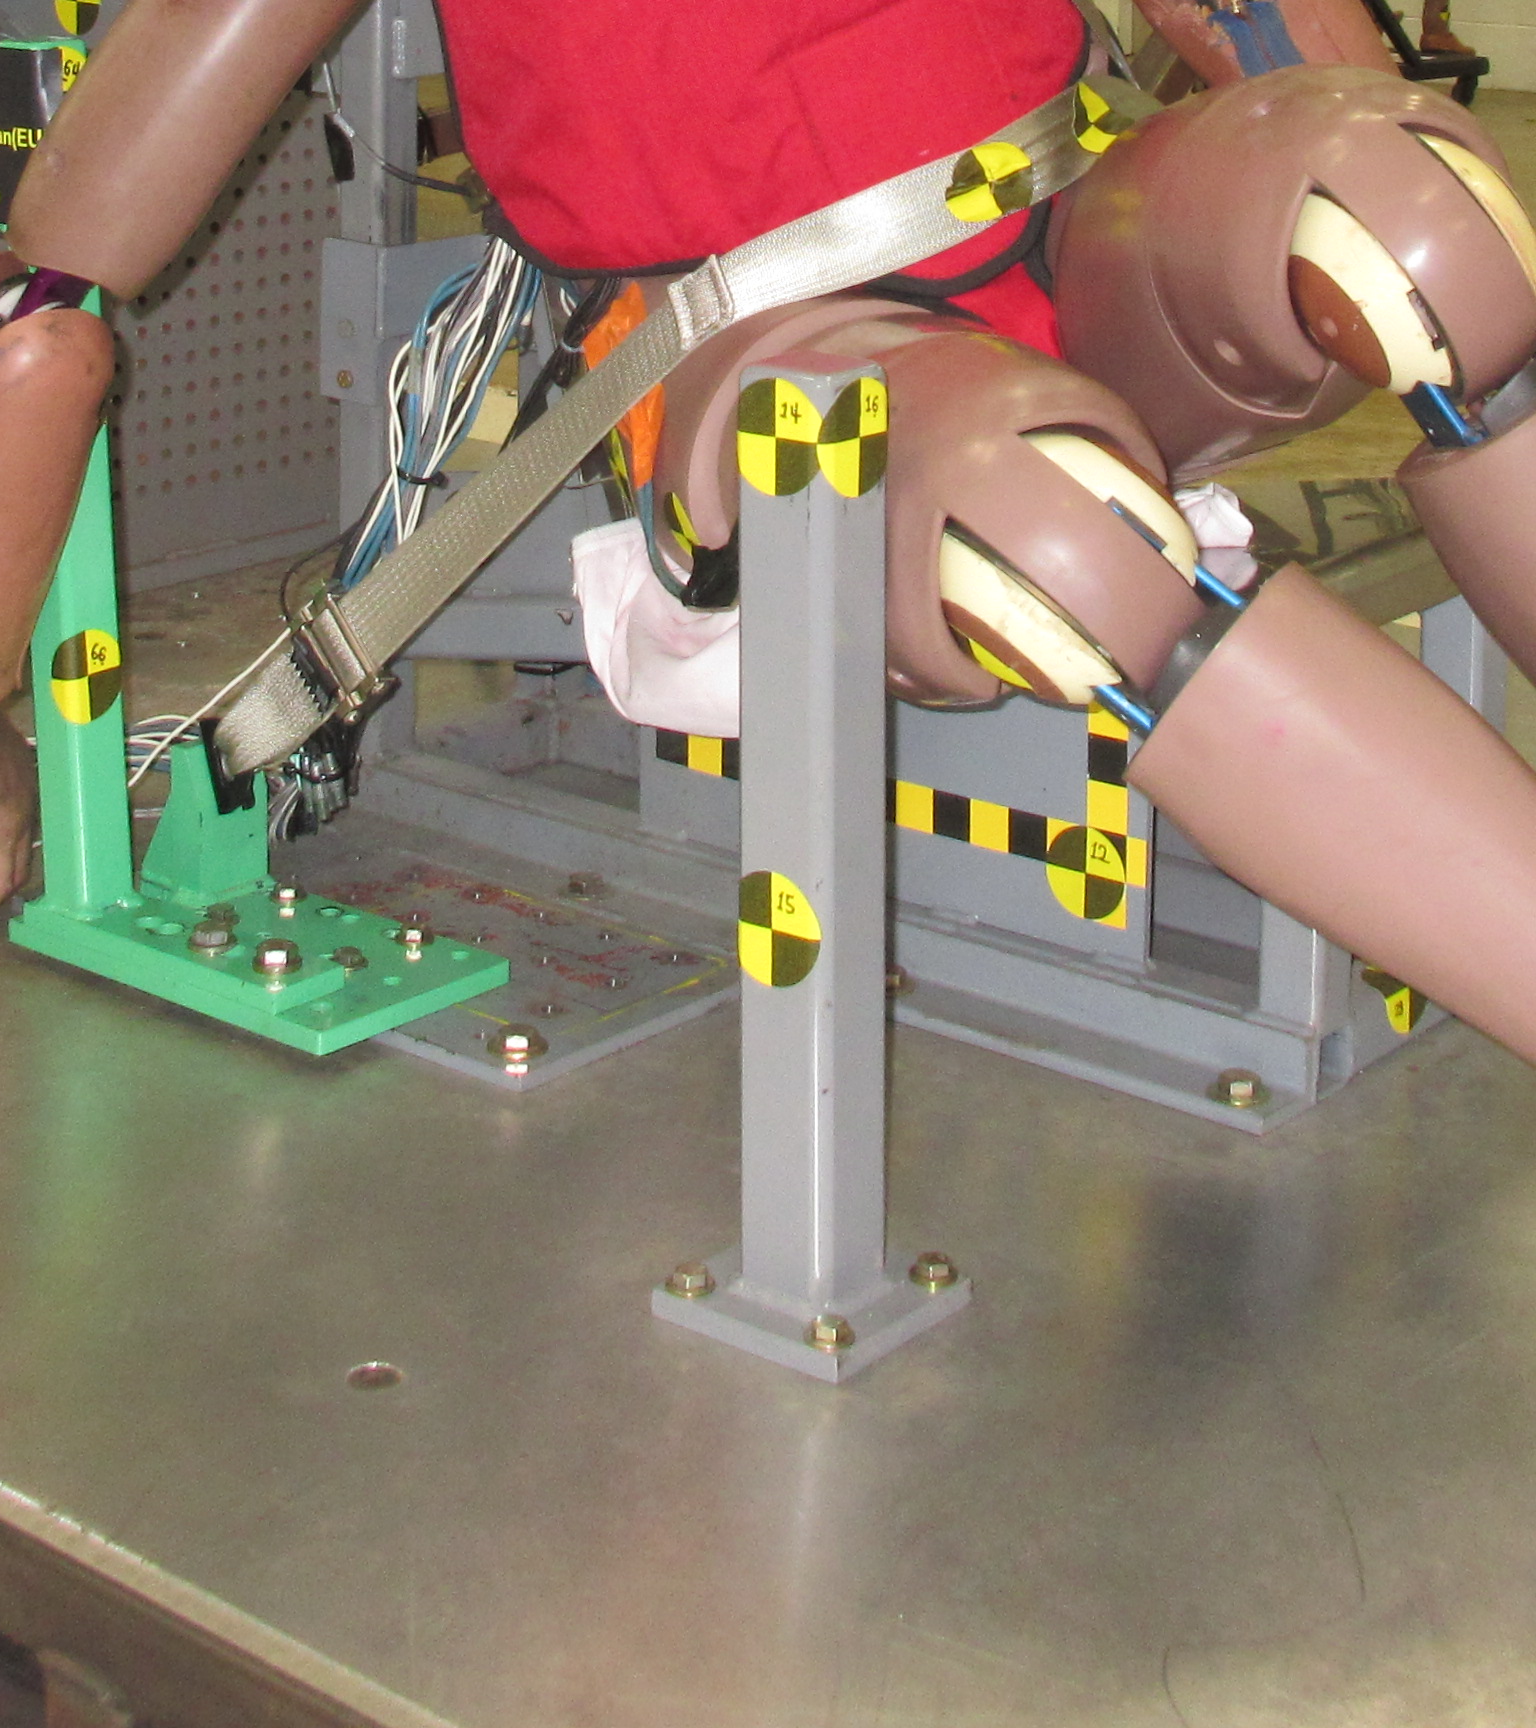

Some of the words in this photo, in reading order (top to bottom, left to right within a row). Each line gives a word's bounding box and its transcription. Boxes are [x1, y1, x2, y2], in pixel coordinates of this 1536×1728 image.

[780, 402, 802, 425] 14
[865, 395, 879, 418] 16
[1090, 841, 1111, 864] 12
[776, 891, 796, 915] 15
